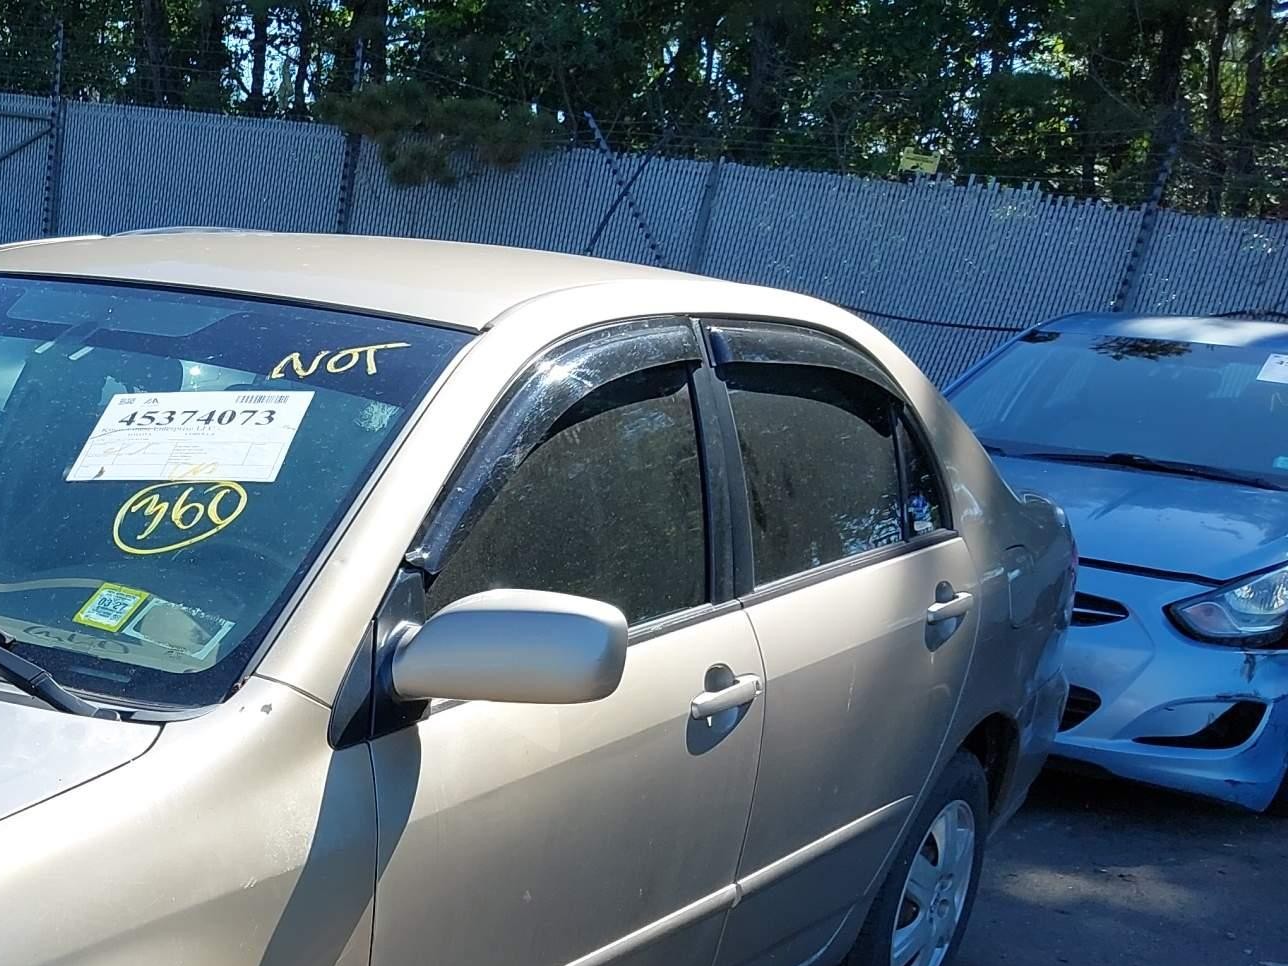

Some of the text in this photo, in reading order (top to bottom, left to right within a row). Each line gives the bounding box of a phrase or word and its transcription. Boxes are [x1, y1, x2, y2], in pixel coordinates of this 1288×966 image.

[267, 342, 411, 380] NOT
[117, 409, 277, 427] 45374073
[130, 479, 248, 541] 360
